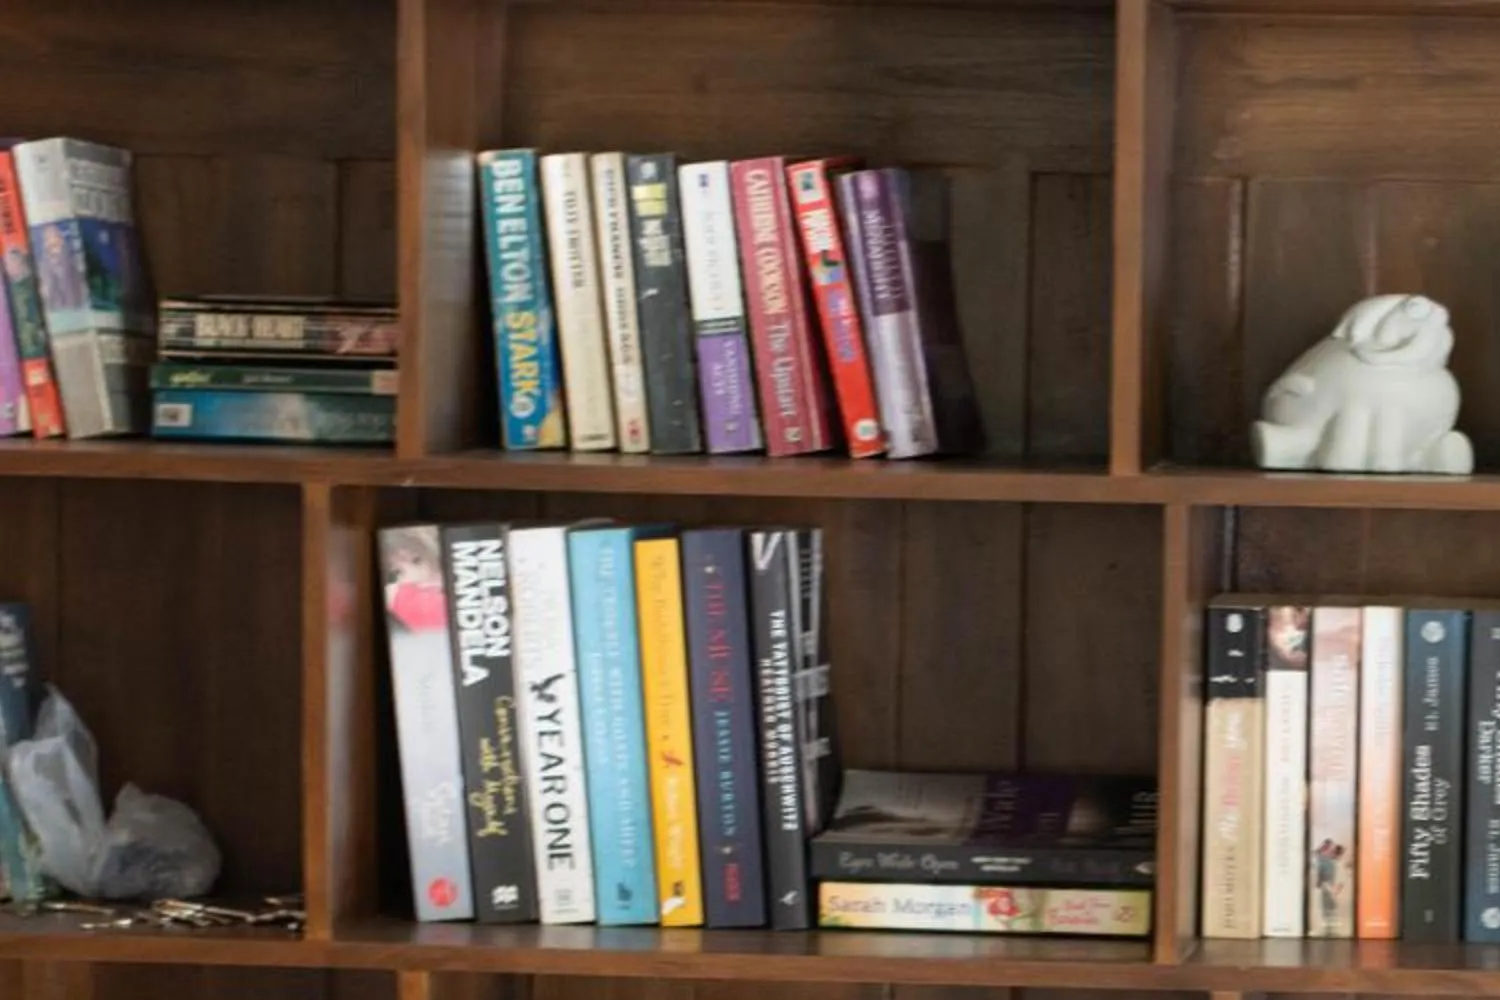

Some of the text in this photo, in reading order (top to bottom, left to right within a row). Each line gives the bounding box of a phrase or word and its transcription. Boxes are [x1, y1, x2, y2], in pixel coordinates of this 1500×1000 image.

[491, 159, 542, 398] BEN ELTON STARK
[744, 169, 798, 417] CATHERINE COOKSON The Upstart
[451, 541, 489, 686] MANDELA
[476, 539, 511, 658] NELSON
[536, 708, 575, 872] YEAR ONE
[770, 610, 798, 831] THE TATTOOIST OF AUSCHWITZ
[1477, 720, 1494, 785] Darker
[1408, 745, 1432, 880] Fifty Shades
